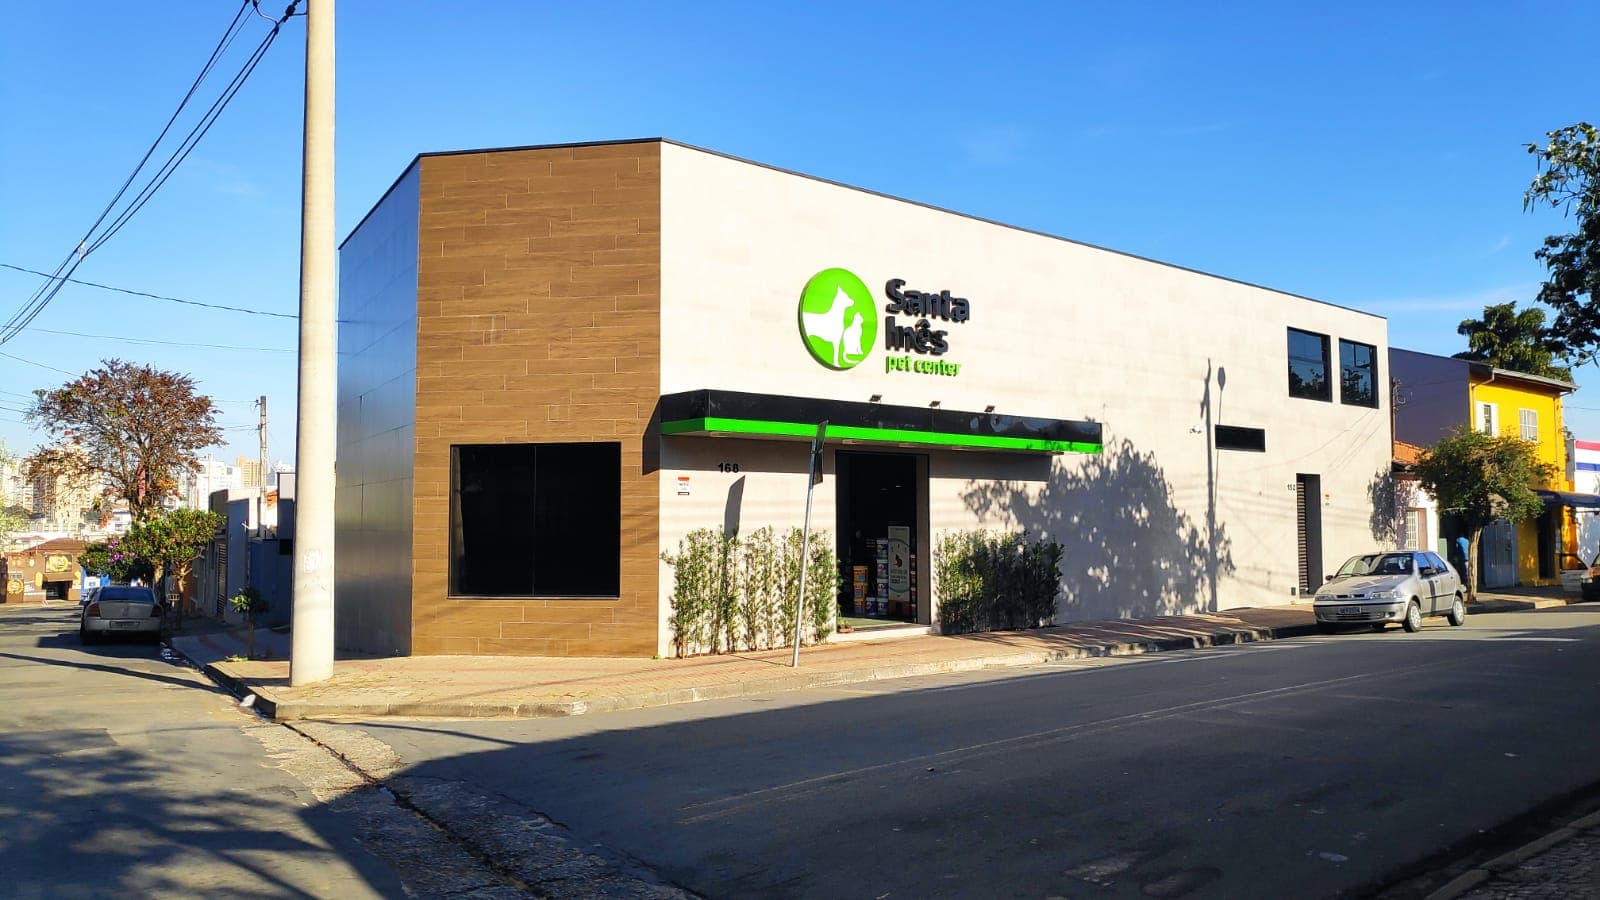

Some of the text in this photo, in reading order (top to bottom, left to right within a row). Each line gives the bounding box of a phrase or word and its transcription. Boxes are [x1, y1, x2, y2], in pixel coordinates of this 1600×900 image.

[885, 278, 970, 323] Santa
[885, 316, 949, 355] Inês
[885, 355, 961, 377] pet center
[718, 462, 740, 473] 168
